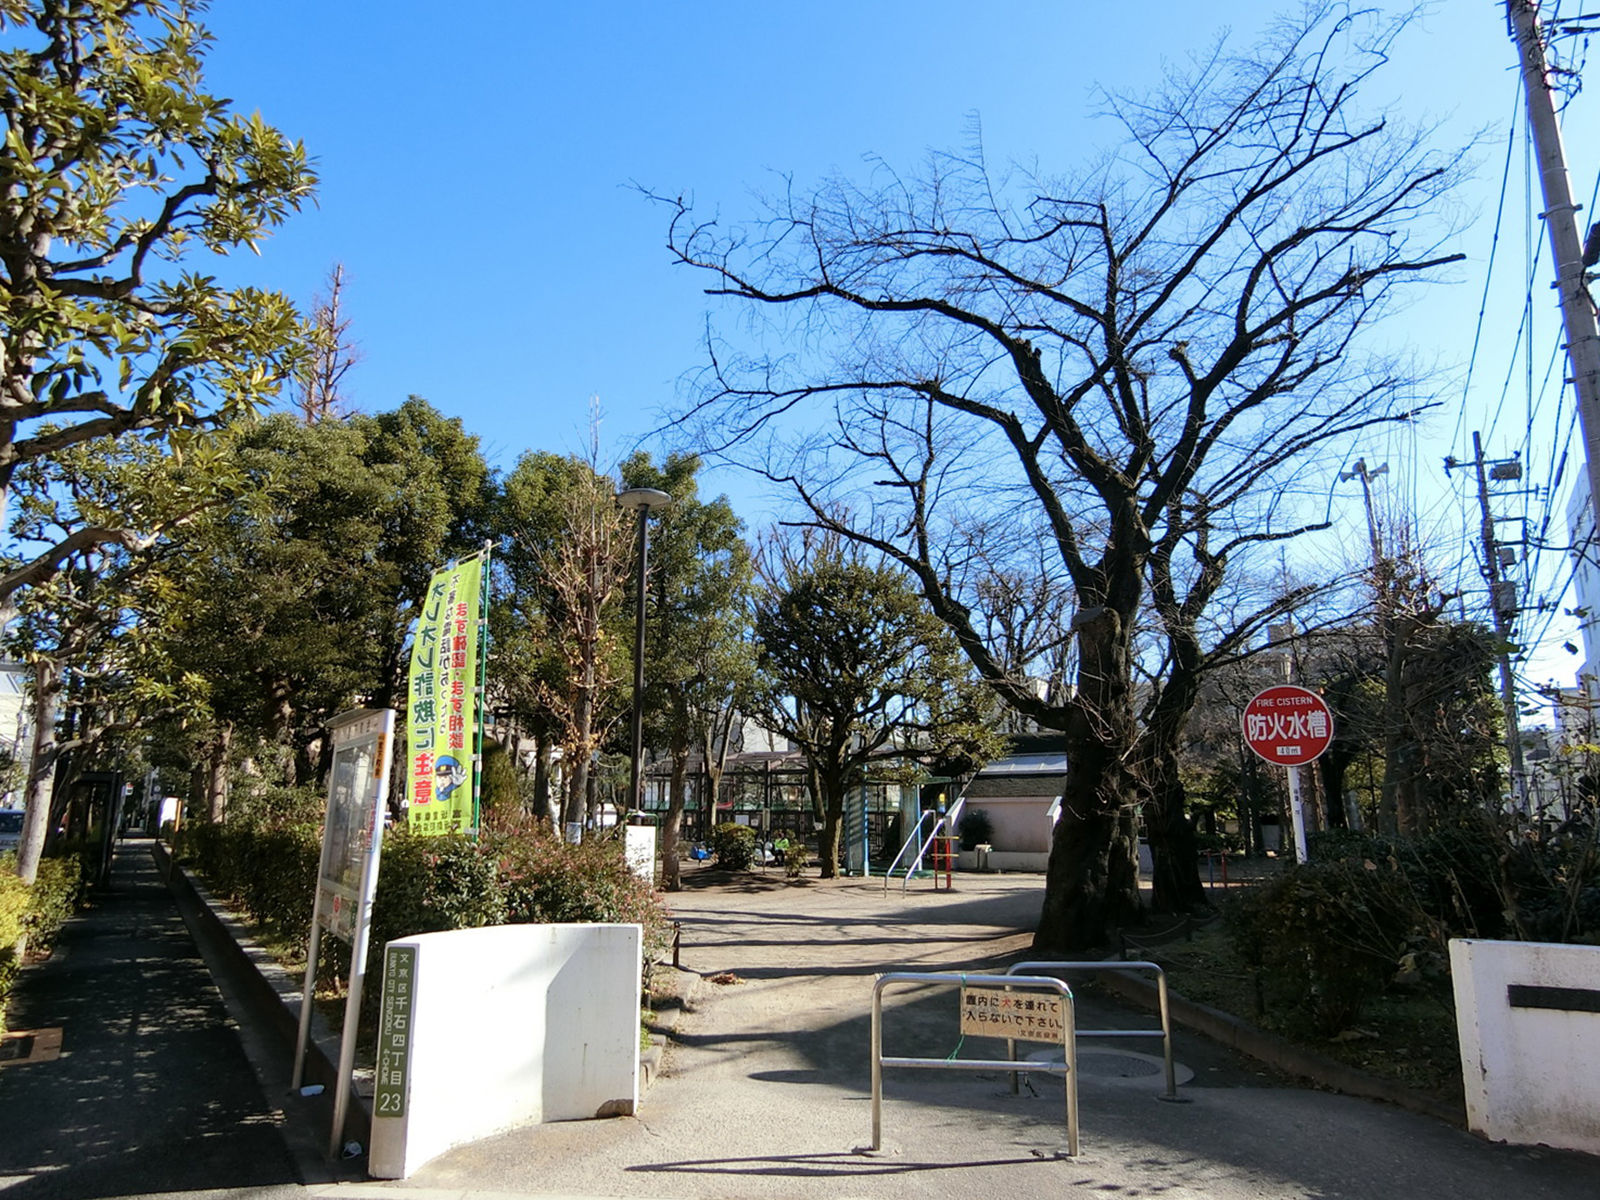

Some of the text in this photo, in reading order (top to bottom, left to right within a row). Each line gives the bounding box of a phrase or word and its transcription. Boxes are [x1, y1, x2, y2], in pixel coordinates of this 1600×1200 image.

[1256, 696, 1313, 708] FIRE CISTERN
[1247, 710, 1327, 741] 防火水槽
[385, 996, 394, 1035] SENGOKU
[380, 1093, 402, 1111] 23
